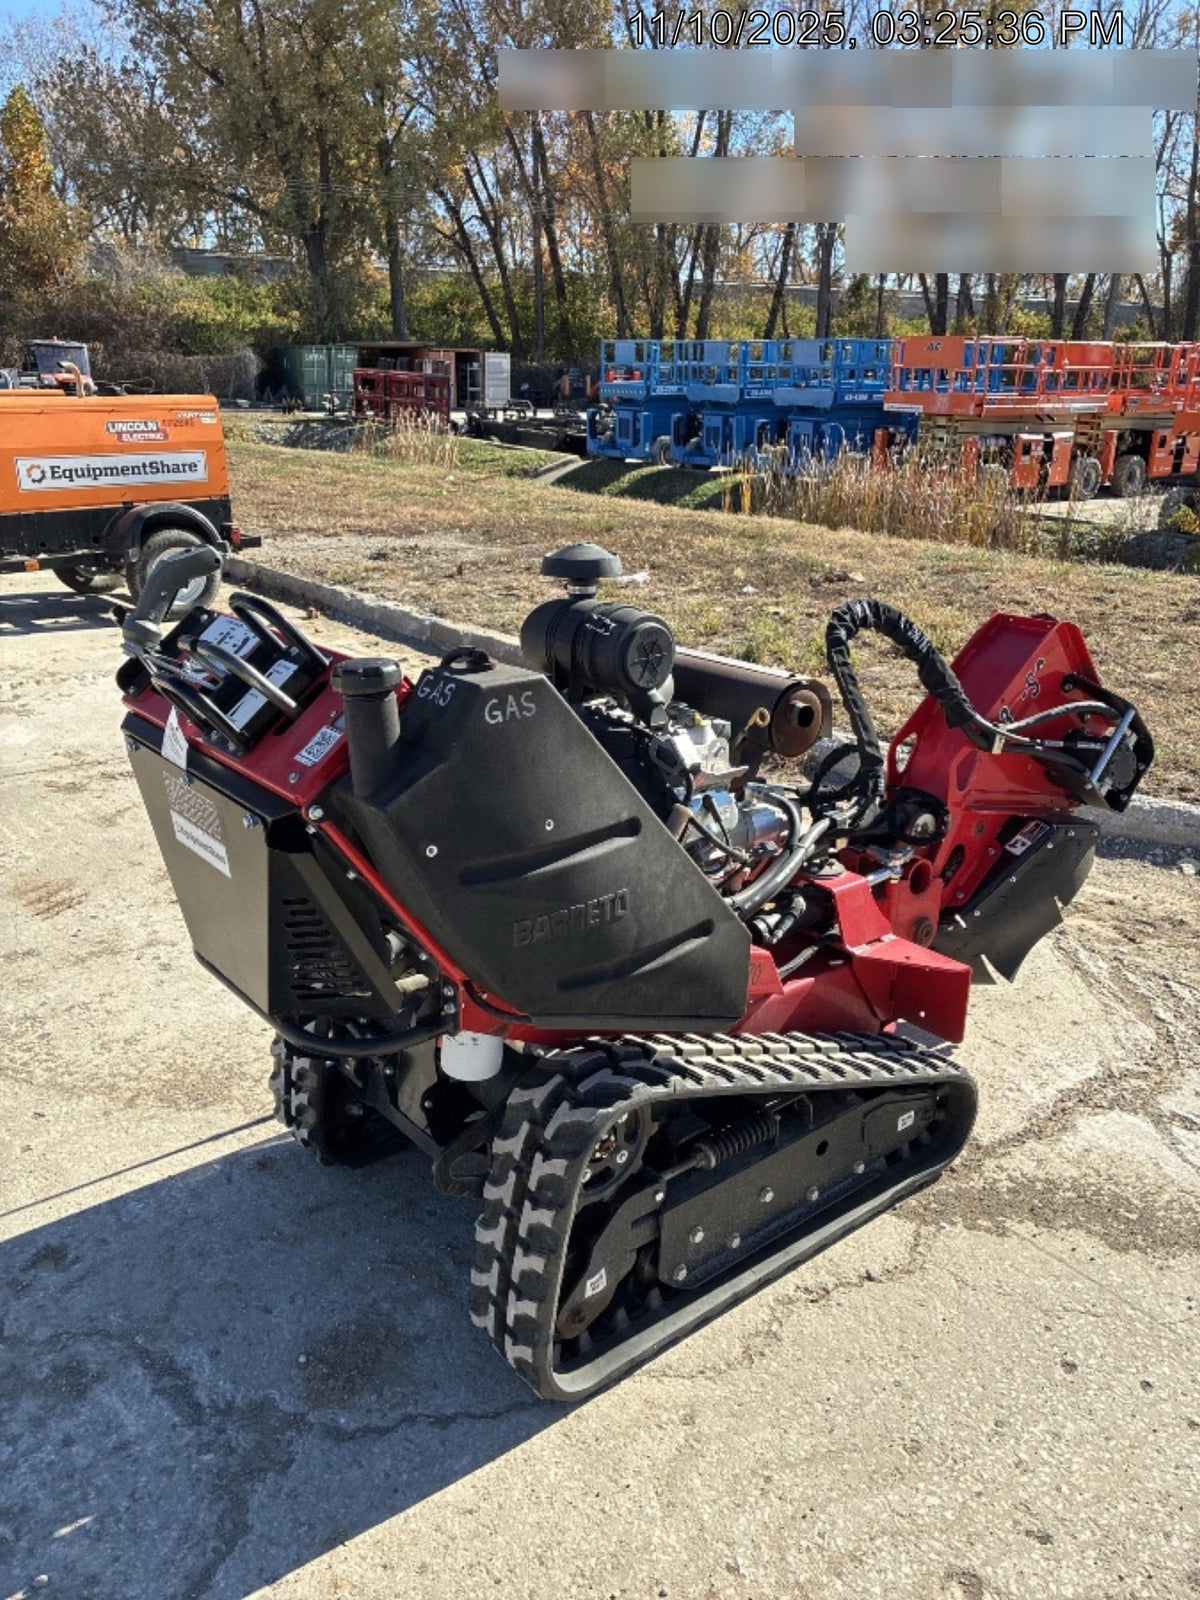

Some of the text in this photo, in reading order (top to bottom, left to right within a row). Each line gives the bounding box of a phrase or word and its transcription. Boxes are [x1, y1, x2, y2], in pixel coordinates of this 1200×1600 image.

[107, 421, 158, 433] LINCOLN
[121, 432, 165, 442] ELECTRIC
[49, 459, 198, 482] EquipmentShare
[417, 674, 456, 707] GAS
[484, 691, 536, 724] GAS
